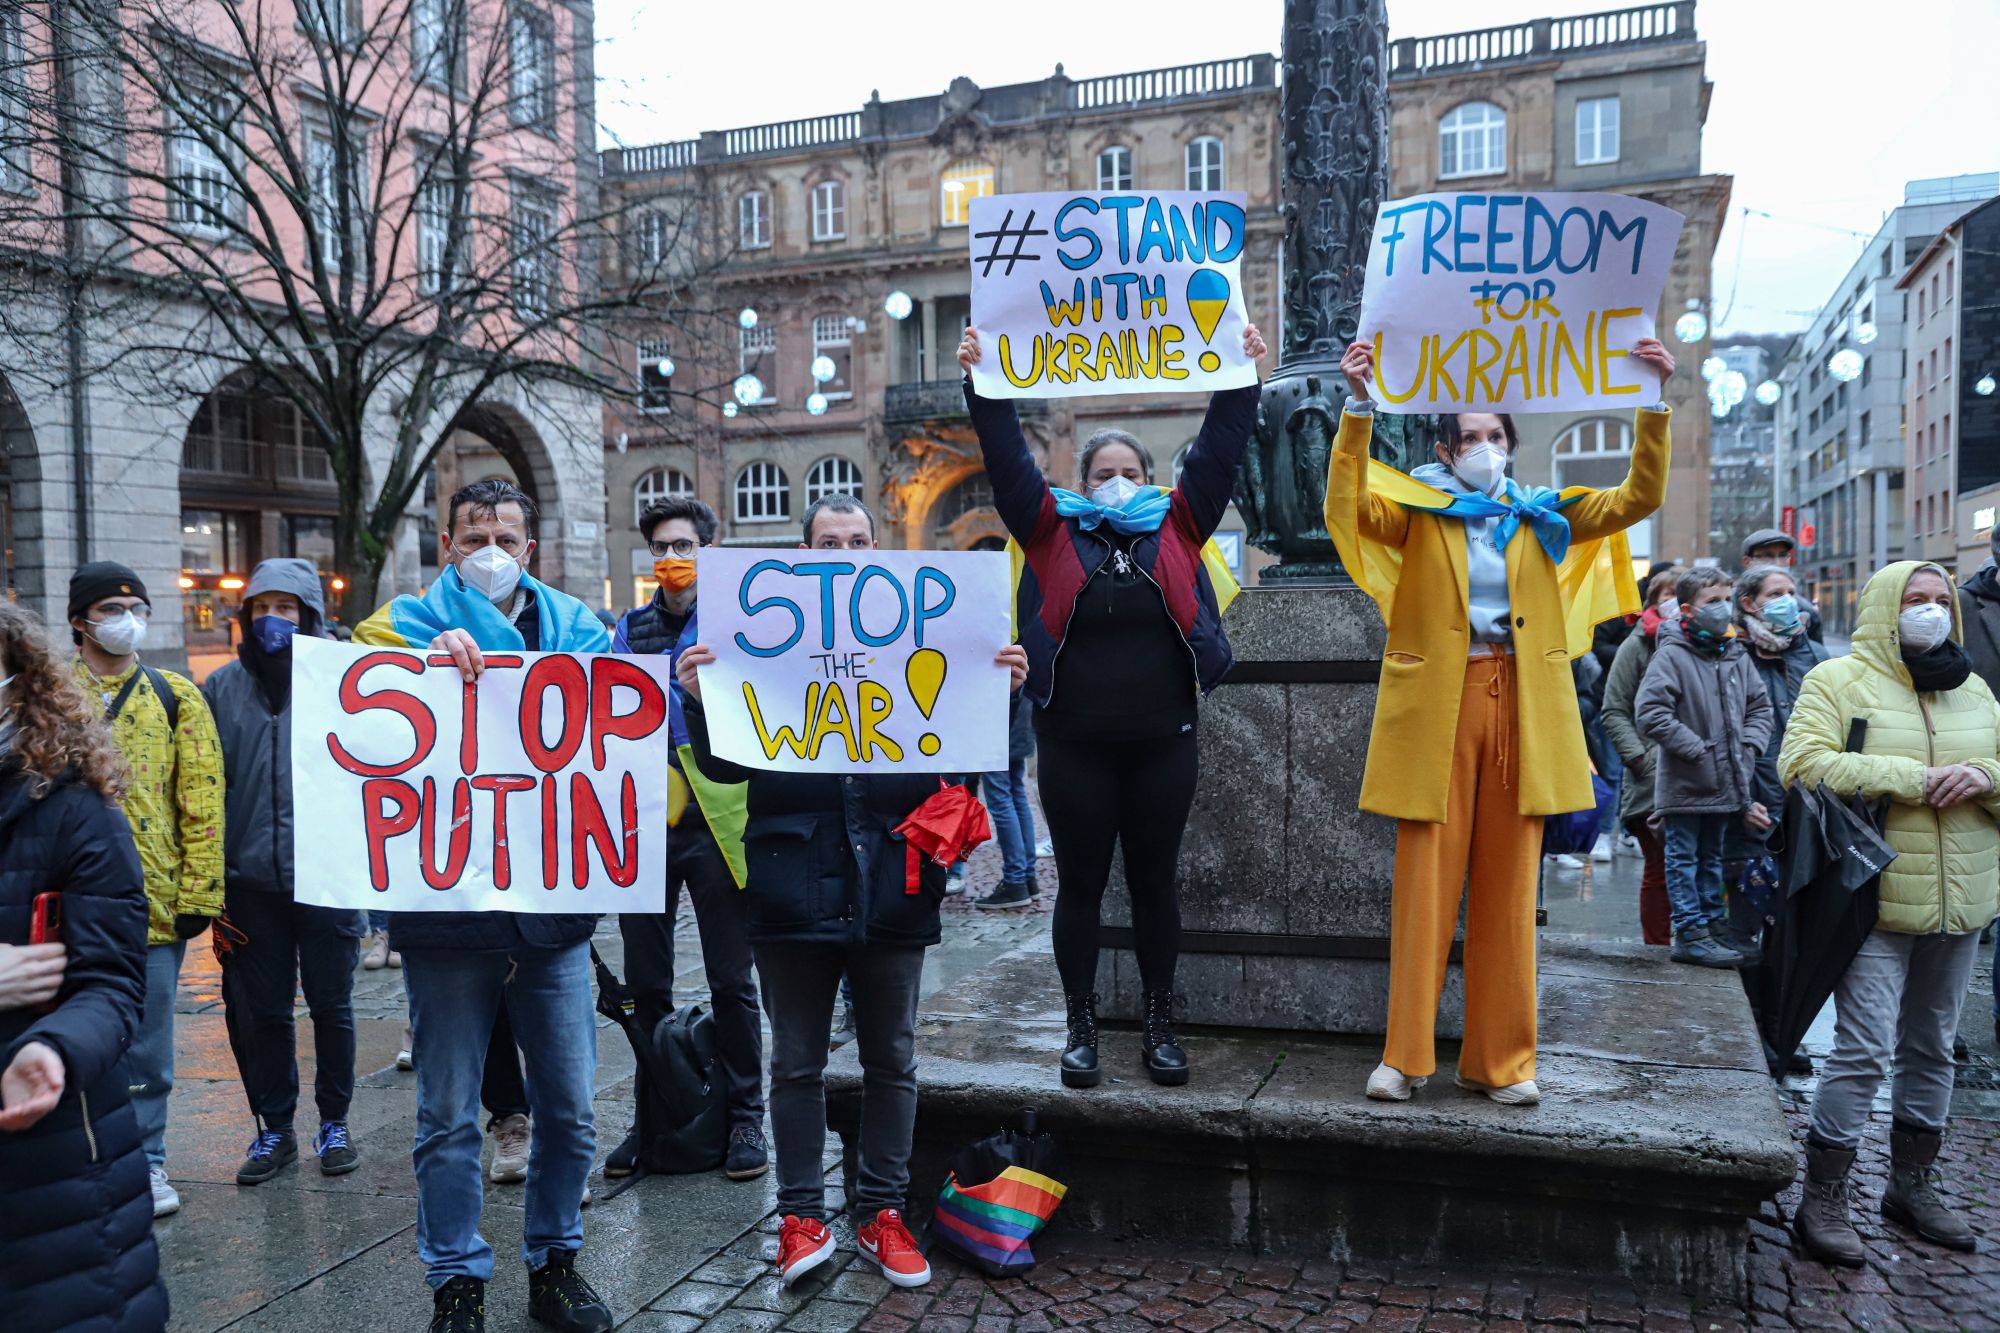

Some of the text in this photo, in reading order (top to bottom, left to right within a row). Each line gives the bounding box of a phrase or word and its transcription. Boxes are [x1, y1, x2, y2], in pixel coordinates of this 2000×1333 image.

[1381, 196, 1648, 276] FREEDOM
[1039, 272, 1168, 328] WITH
[1469, 279, 1561, 324] FOR
[1372, 307, 1643, 404] UKRAINE
[734, 559, 956, 658] STOP
[741, 647, 948, 763] WAR!
[809, 652, 868, 679] THE
[326, 651, 667, 778] STOP
[362, 771, 639, 892] PUTIN
